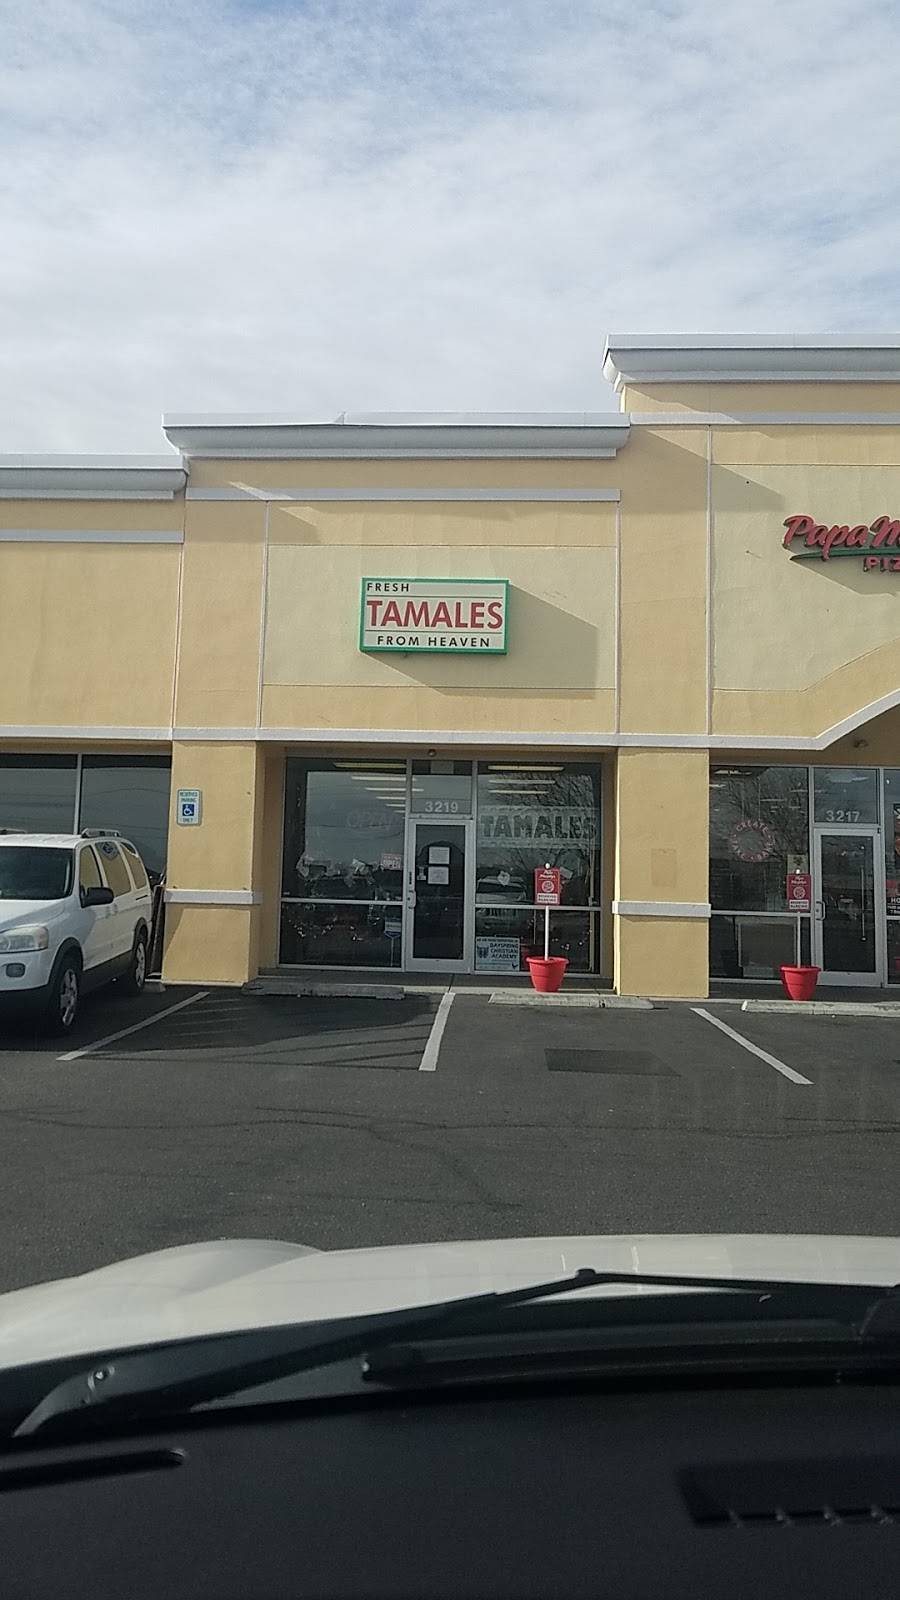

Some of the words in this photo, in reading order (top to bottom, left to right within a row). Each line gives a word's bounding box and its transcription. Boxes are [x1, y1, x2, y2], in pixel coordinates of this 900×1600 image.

[782, 514, 869, 561] Papa
[366, 582, 410, 592] FRESH
[366, 600, 503, 629] TAMALES
[377, 635, 420, 646] FROM
[427, 636, 490, 647] HEAVEN
[424, 801, 459, 813] 3219
[825, 810, 860, 823] 3217
[480, 815, 597, 839] TAMALES
